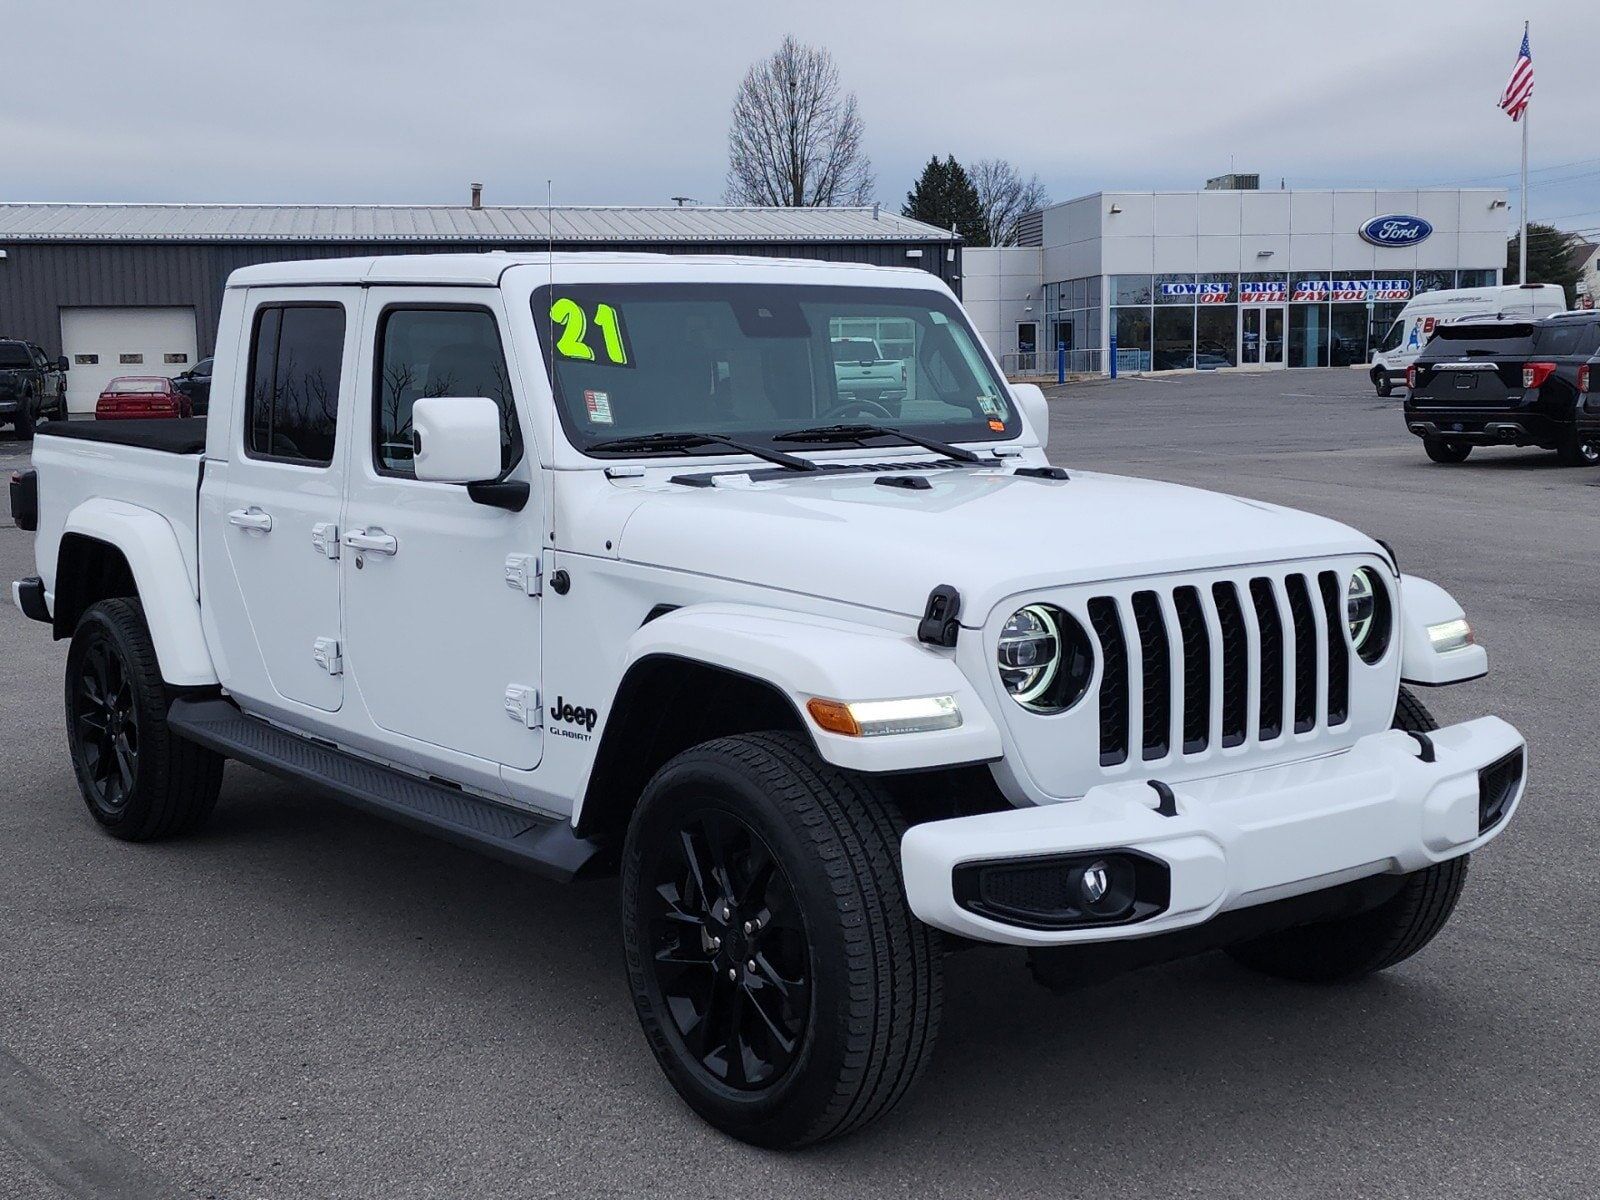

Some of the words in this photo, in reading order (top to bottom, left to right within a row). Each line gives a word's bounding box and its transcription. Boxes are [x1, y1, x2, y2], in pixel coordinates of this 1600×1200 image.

[1379, 220, 1420, 240] Ford
[1162, 283, 1231, 295] LOWEST
[1240, 282, 1287, 293] PRICE
[1200, 293, 1227, 303] OR
[1293, 290, 1328, 301] PAY
[1332, 290, 1367, 300] YOU
[550, 298, 627, 364] 21
[550, 695, 598, 733] Jeep
[549, 726, 592, 742] GLADIAT
